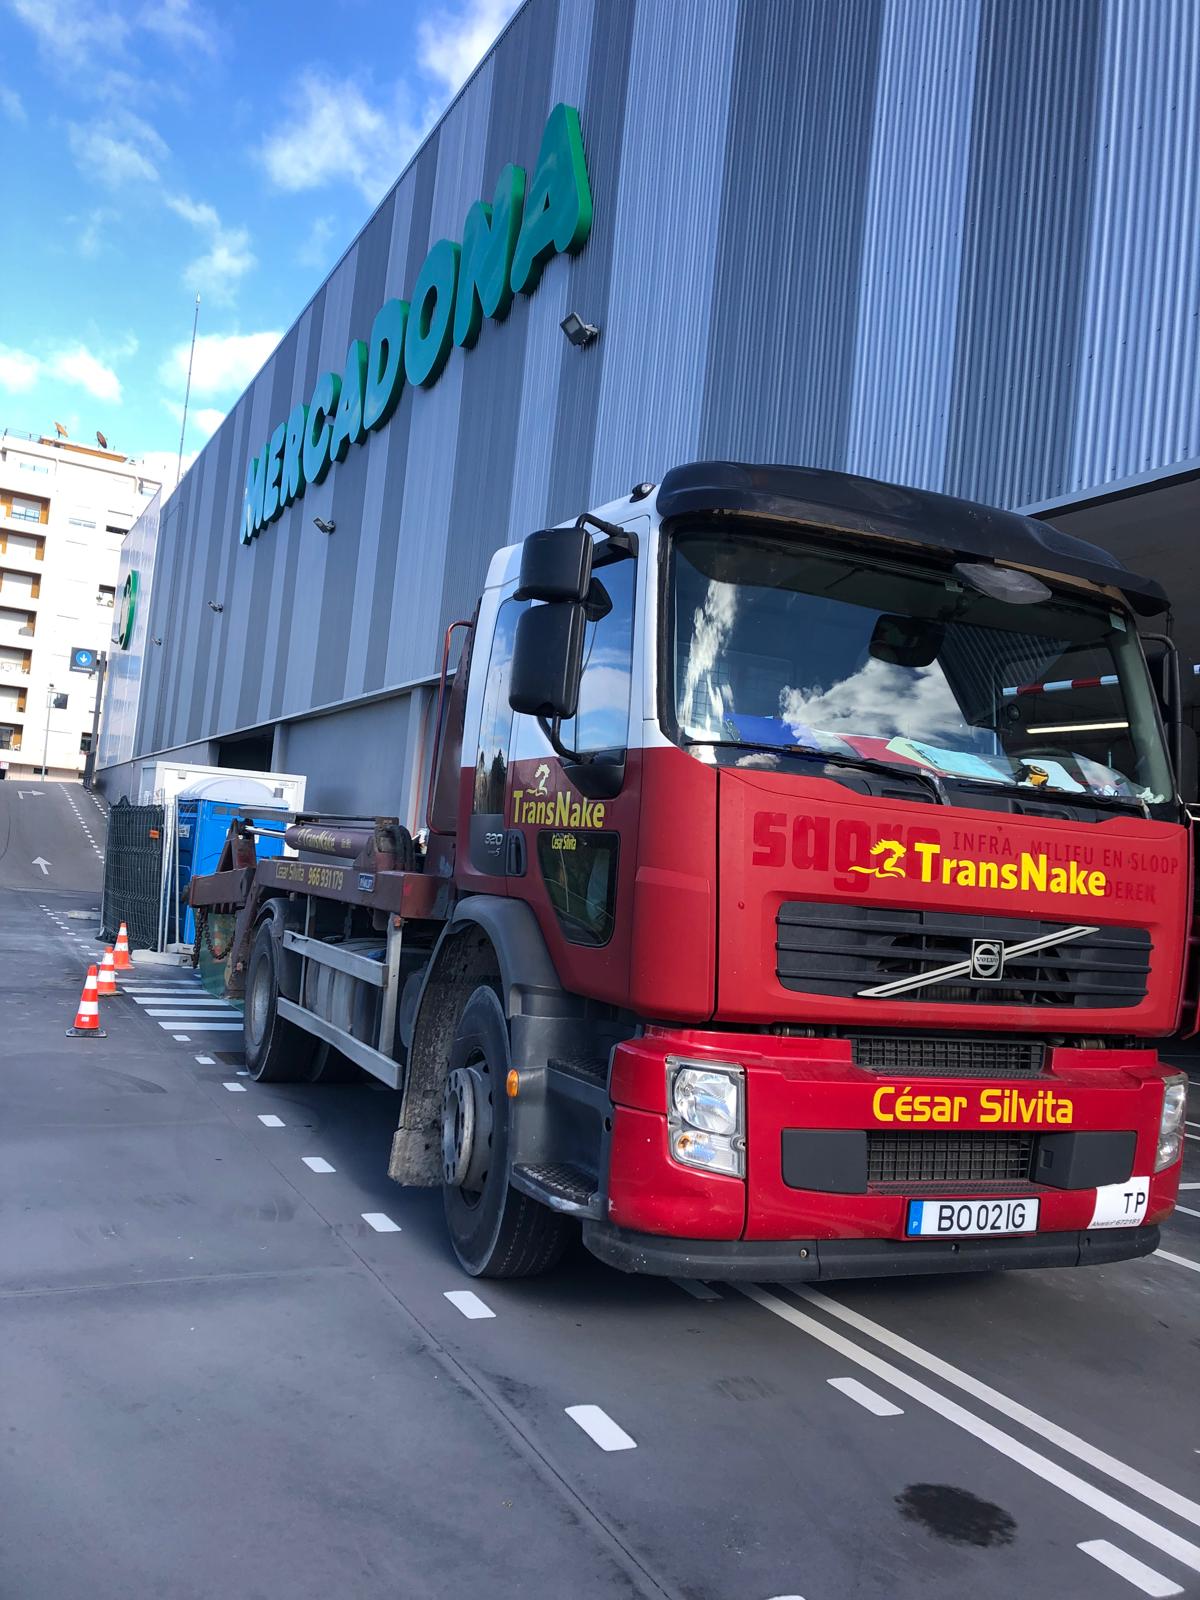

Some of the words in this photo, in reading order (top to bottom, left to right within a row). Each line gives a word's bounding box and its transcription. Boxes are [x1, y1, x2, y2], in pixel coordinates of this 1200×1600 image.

[240, 103, 593, 546] MERCADONA
[513, 790, 605, 828] TransNake
[485, 832, 503, 846] 320
[914, 842, 1107, 897] TransNake
[1103, 848, 1123, 868] EN
[1130, 852, 1179, 875] SLOOP
[872, 1086, 968, 1122] César
[979, 1089, 1074, 1124] Silvita
